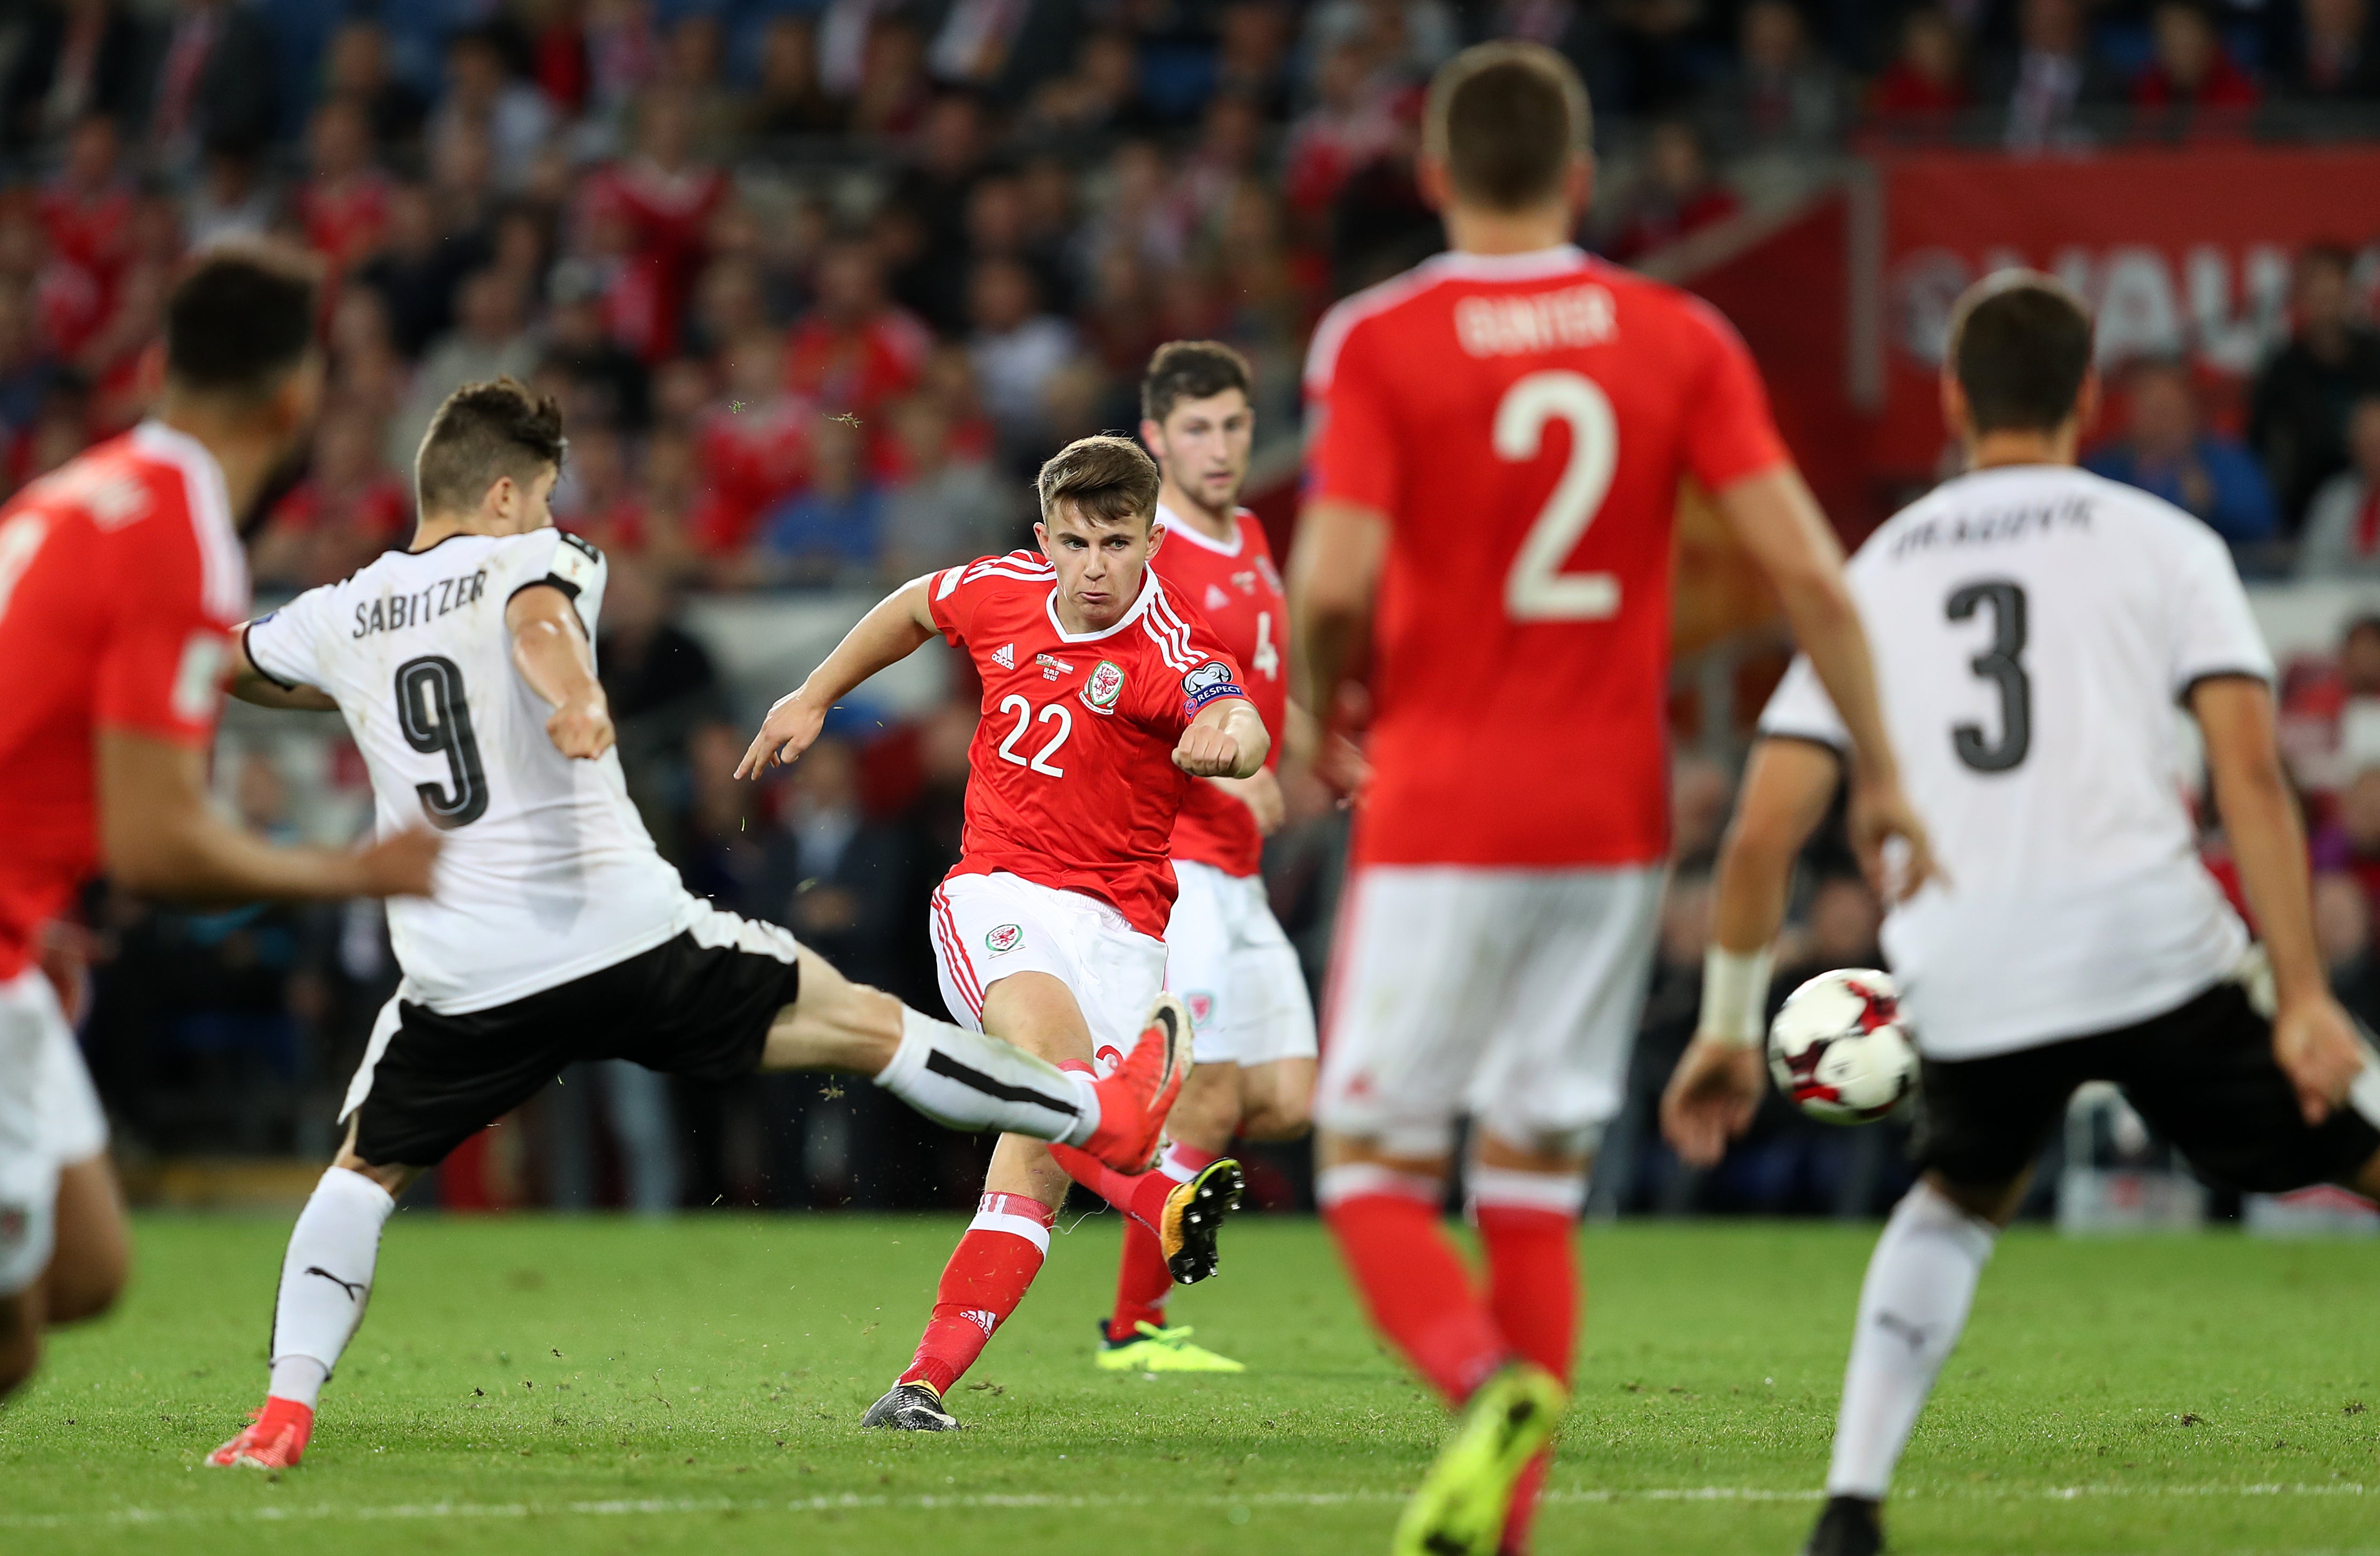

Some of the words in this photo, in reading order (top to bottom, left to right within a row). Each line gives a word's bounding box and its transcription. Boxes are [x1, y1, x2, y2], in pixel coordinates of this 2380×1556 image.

[1492, 369, 1623, 622] 2
[353, 570, 487, 639] SABITZER
[991, 653, 1015, 670] adidas
[1252, 610, 1279, 682] 4
[1946, 578, 2033, 775] 3
[1197, 686, 1241, 702] RESPECT
[395, 655, 489, 830] 9
[998, 694, 1072, 778] 22
[959, 1311, 990, 1340] adidas
